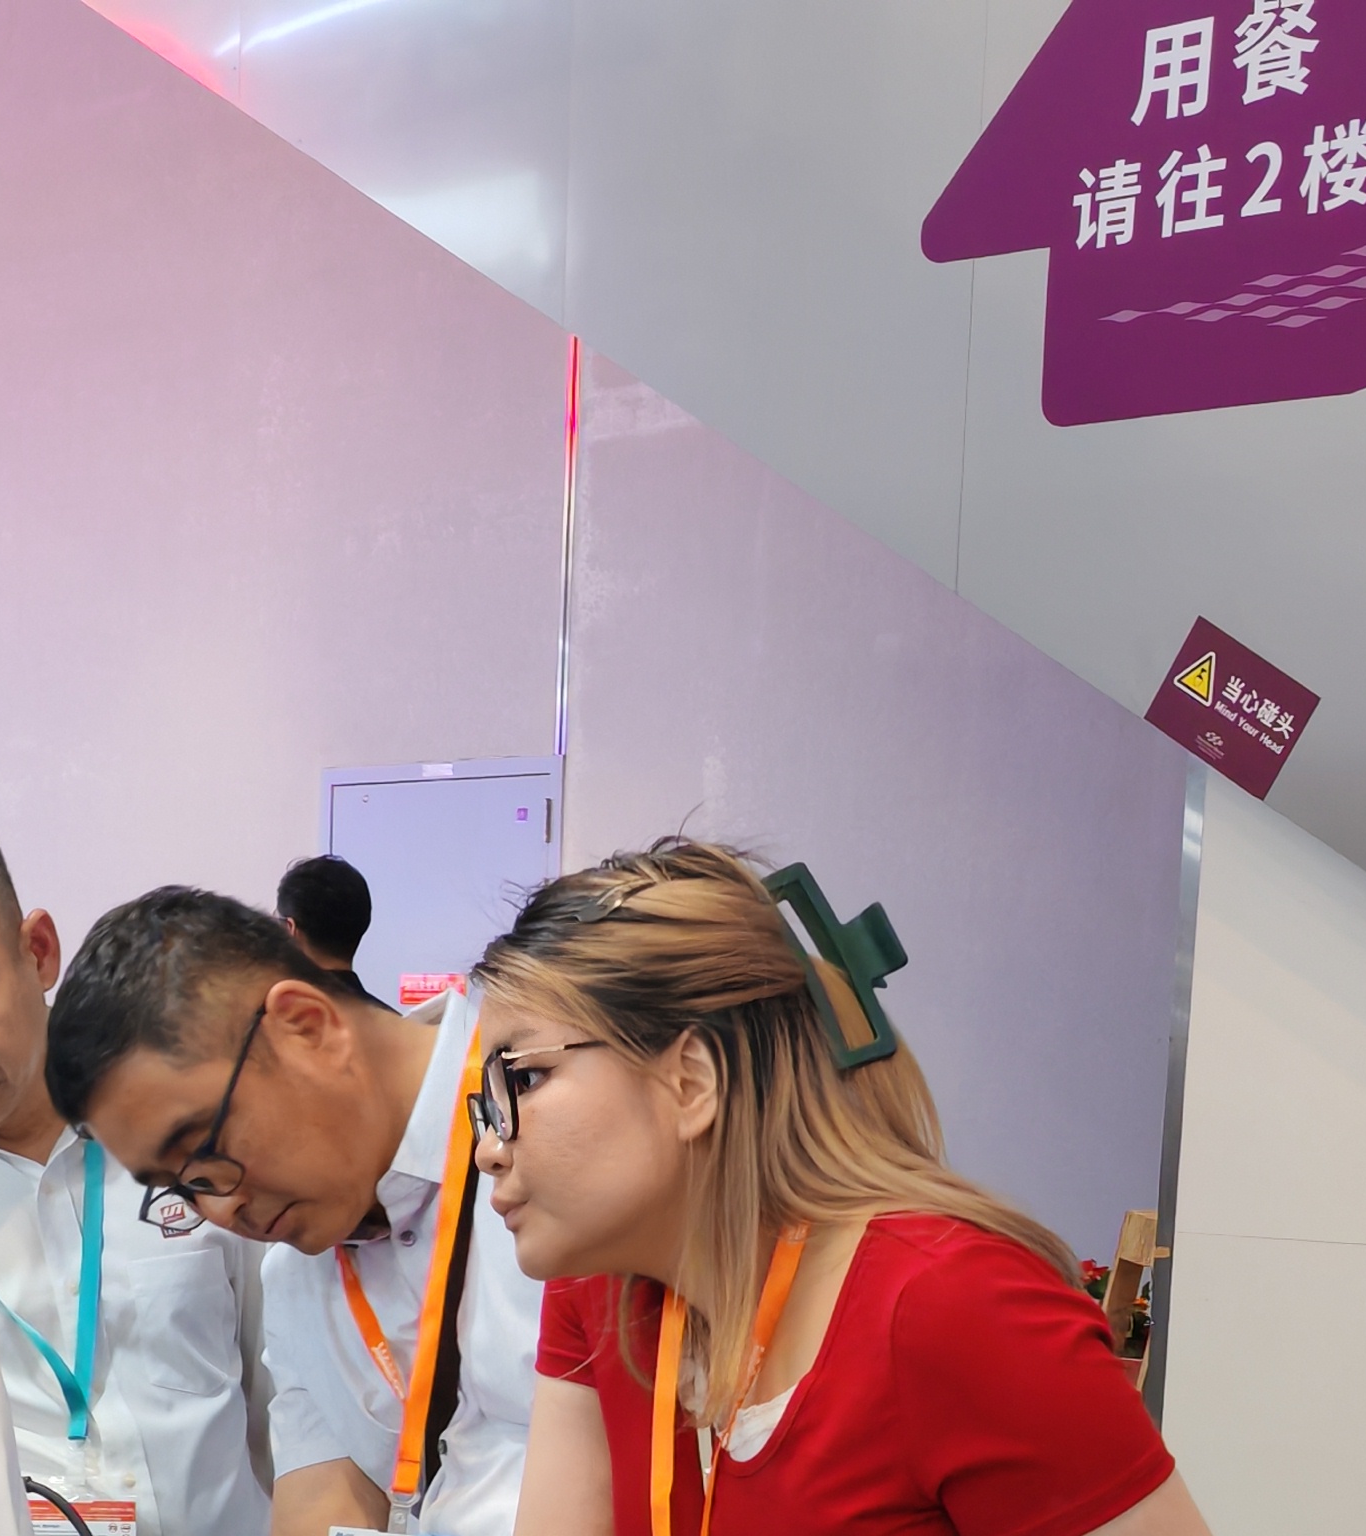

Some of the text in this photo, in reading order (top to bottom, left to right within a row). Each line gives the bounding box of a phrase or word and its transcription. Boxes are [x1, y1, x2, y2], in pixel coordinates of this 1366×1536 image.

[1131, 0, 1320, 126] 用餐
[1214, 700, 1285, 755] Mind Your Head
[1221, 675, 1295, 740] 当心碰头
